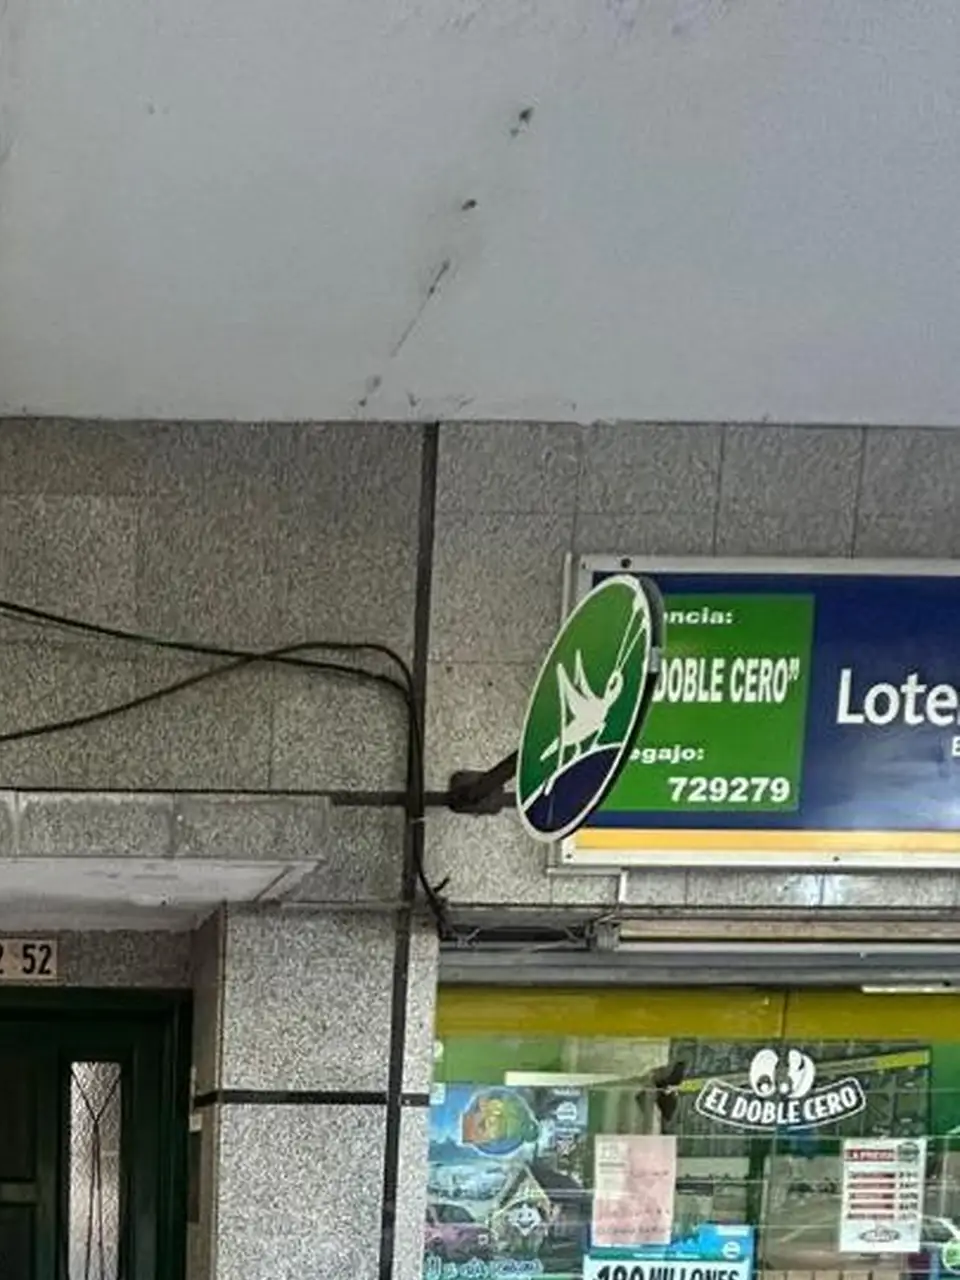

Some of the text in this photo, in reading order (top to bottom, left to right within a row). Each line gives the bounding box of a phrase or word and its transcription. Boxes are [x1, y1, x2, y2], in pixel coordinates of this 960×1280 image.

[837, 668, 960, 726] Lote
[668, 776, 791, 803] 729279
[704, 1086, 858, 1124] EL DOBLE CERO
